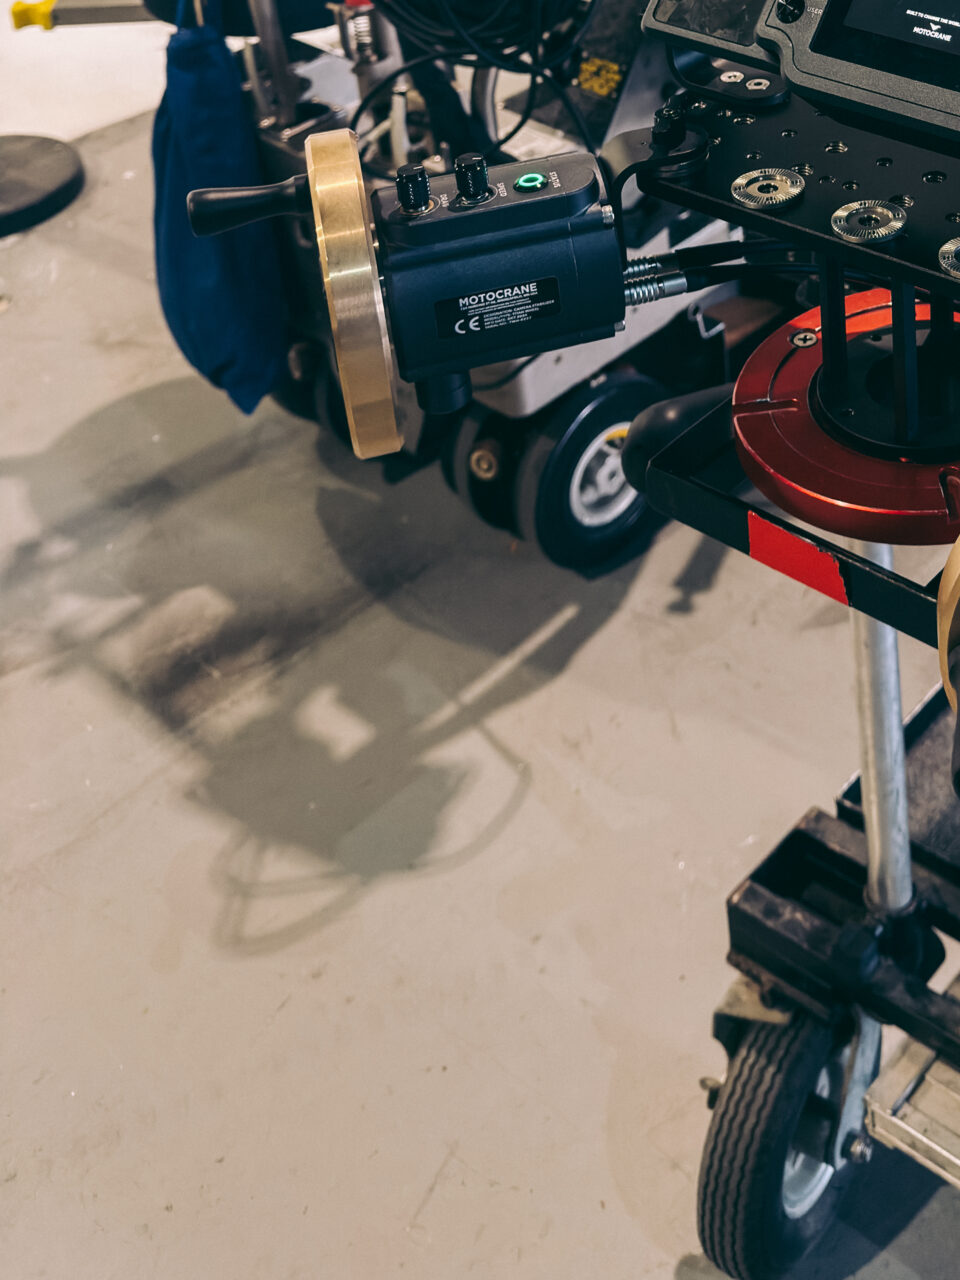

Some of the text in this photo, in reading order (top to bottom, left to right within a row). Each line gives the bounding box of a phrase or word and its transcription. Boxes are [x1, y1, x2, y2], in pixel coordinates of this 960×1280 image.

[807, 6, 823, 14] USER
[912, 26, 952, 42] MOTOCRANE
[549, 171, 561, 188] STATUS
[496, 182, 508, 197] SPEED
[458, 282, 538, 308] MOTOCRANE
[454, 315, 481, 334] CE
